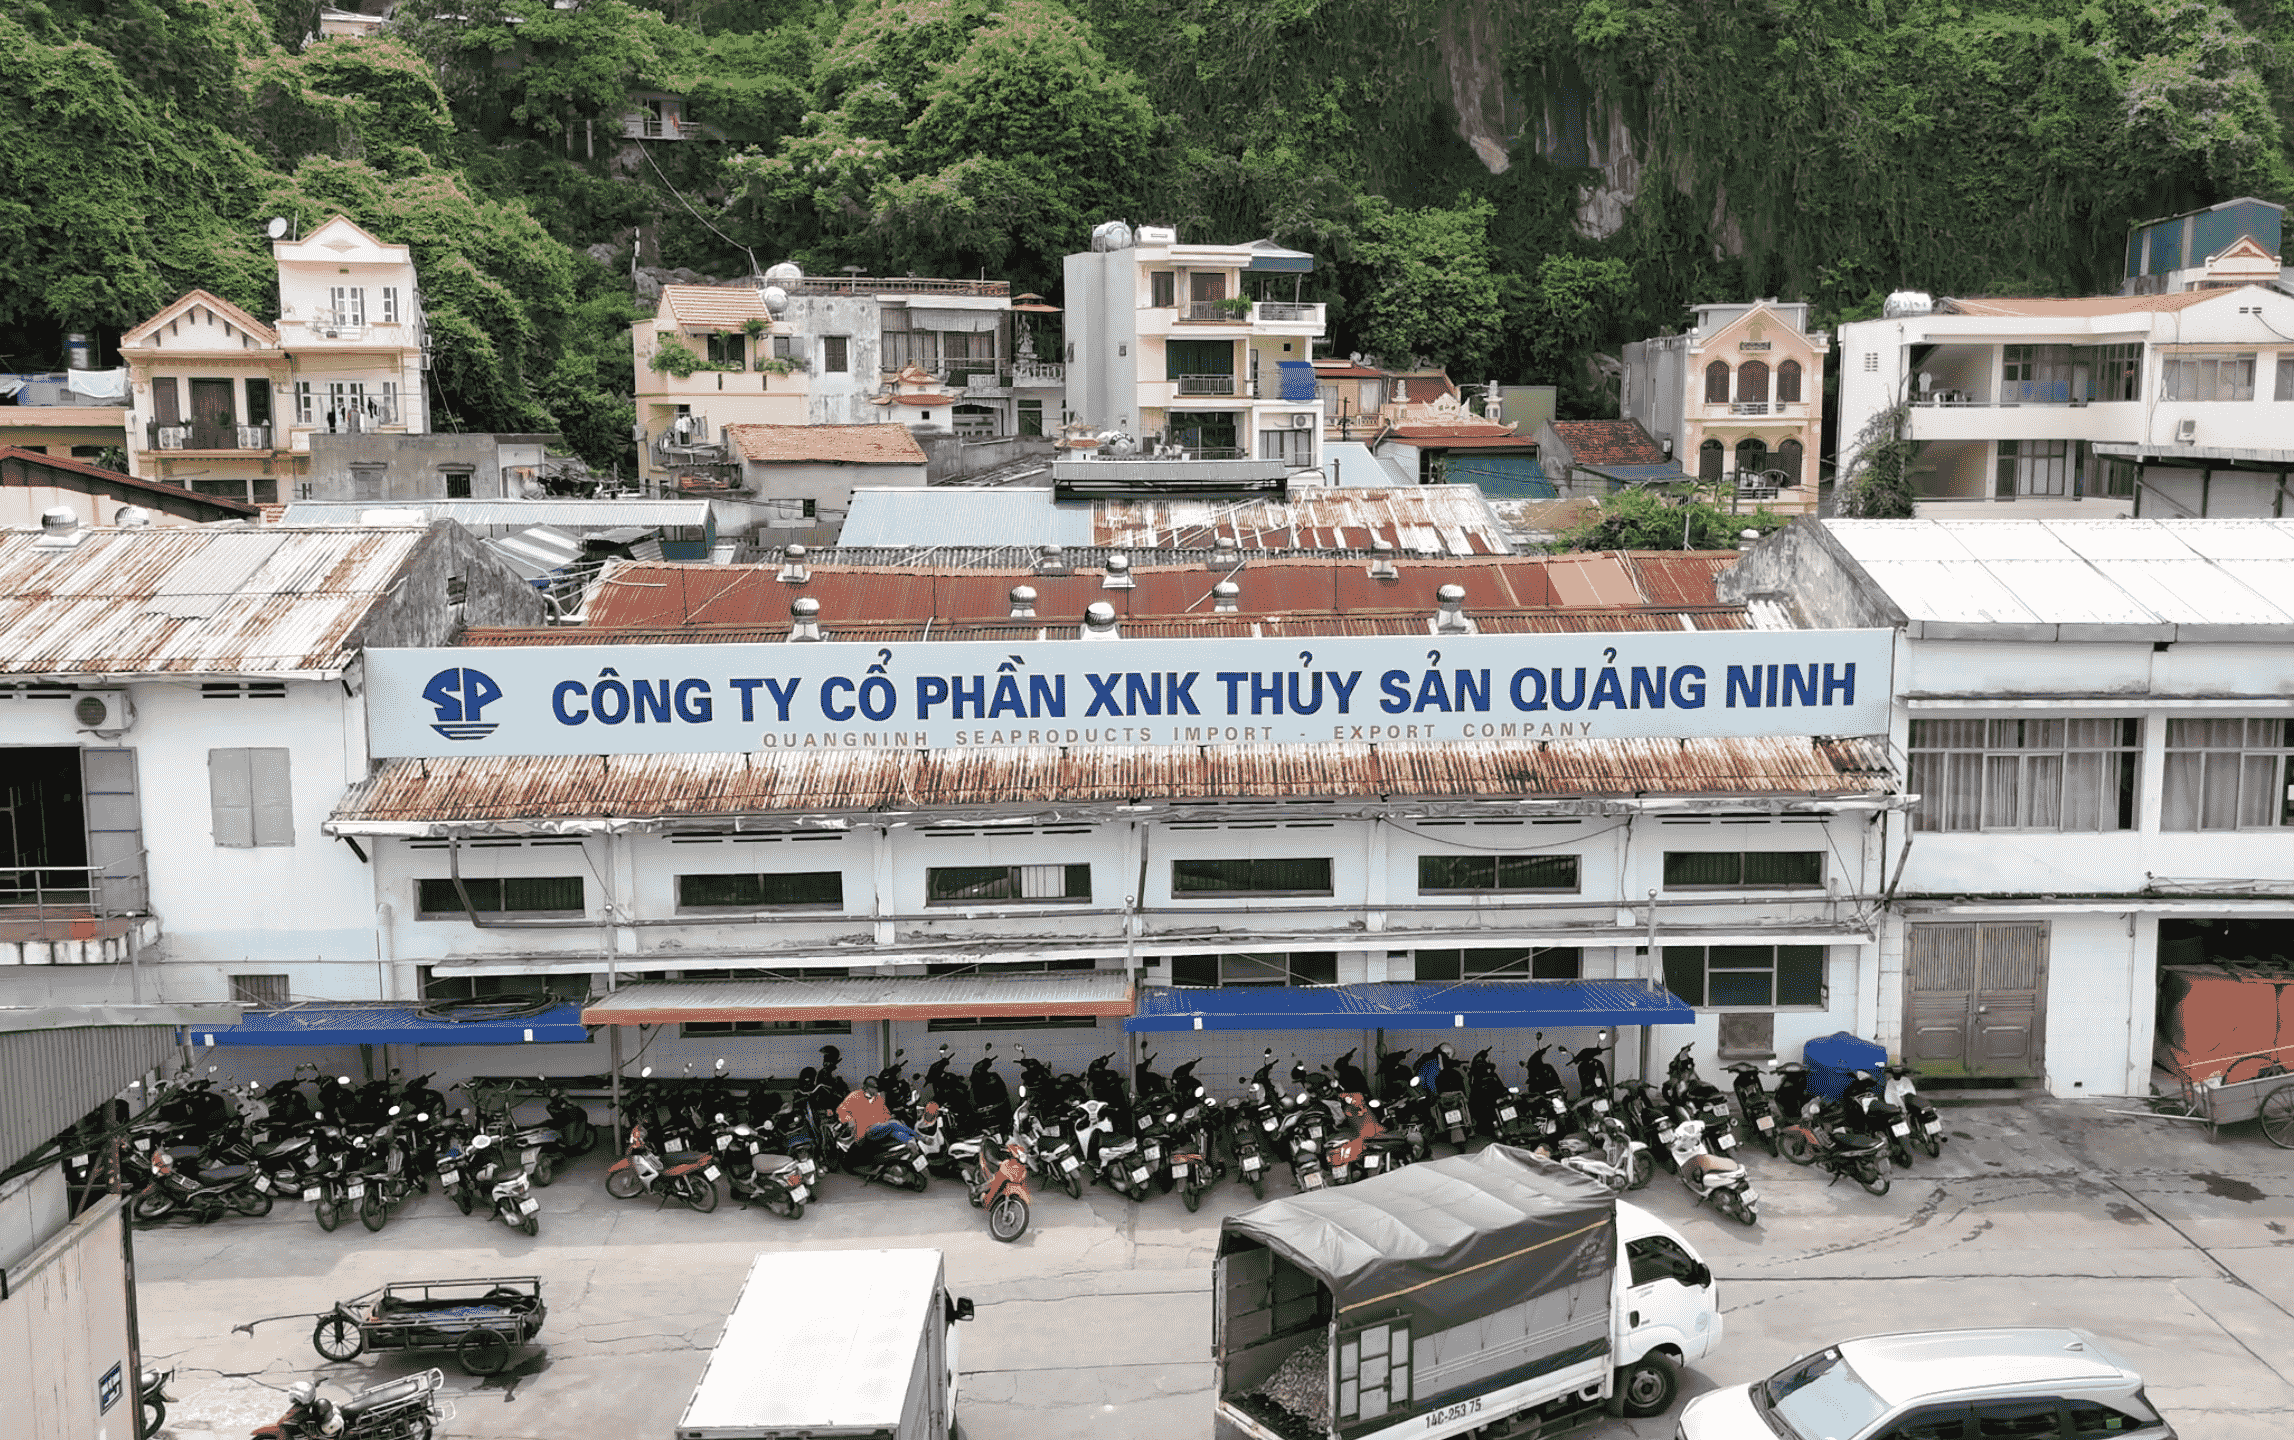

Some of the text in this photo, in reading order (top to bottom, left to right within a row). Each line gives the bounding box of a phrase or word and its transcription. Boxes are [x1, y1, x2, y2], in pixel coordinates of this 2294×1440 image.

[422, 667, 503, 722] SP
[552, 648, 1856, 726] CÔNG TY CỔ PHẦN XNK THỦY SẢN QUẢNG NINH
[763, 731, 928, 748] QUANGNINH
[955, 728, 1152, 746] SEAPRODUCTS
[1173, 726, 1273, 742] IMPORT
[1333, 723, 1436, 740] EXPORT
[1462, 721, 1592, 738] COMPANY
[1425, 1398, 1482, 1429] 14C-253 75
